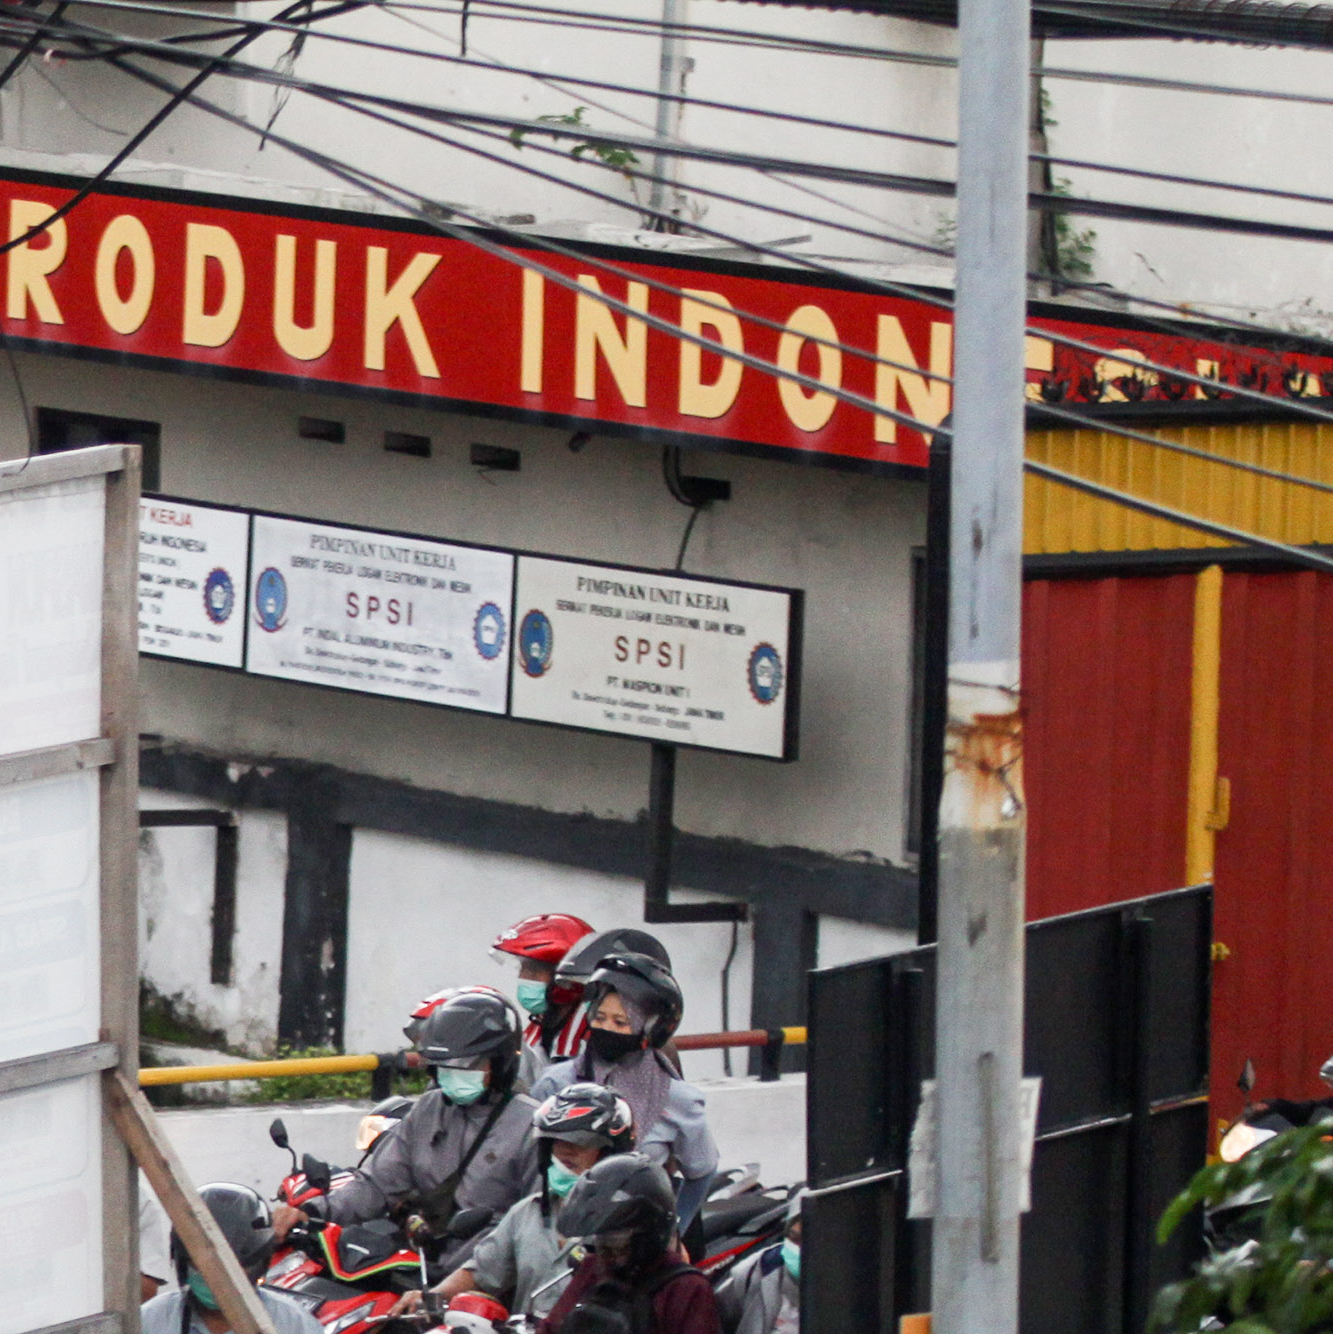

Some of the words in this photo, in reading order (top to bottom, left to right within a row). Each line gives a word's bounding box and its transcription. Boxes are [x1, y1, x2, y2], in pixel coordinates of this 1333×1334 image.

[310, 534, 377, 557] PIMPINAN
[380, 544, 412, 563] UNIT
[413, 550, 457, 571] KERJA
[577, 576, 645, 601] PIMPINAN
[650, 587, 681, 606] UNIT
[686, 592, 730, 613] KERJA
